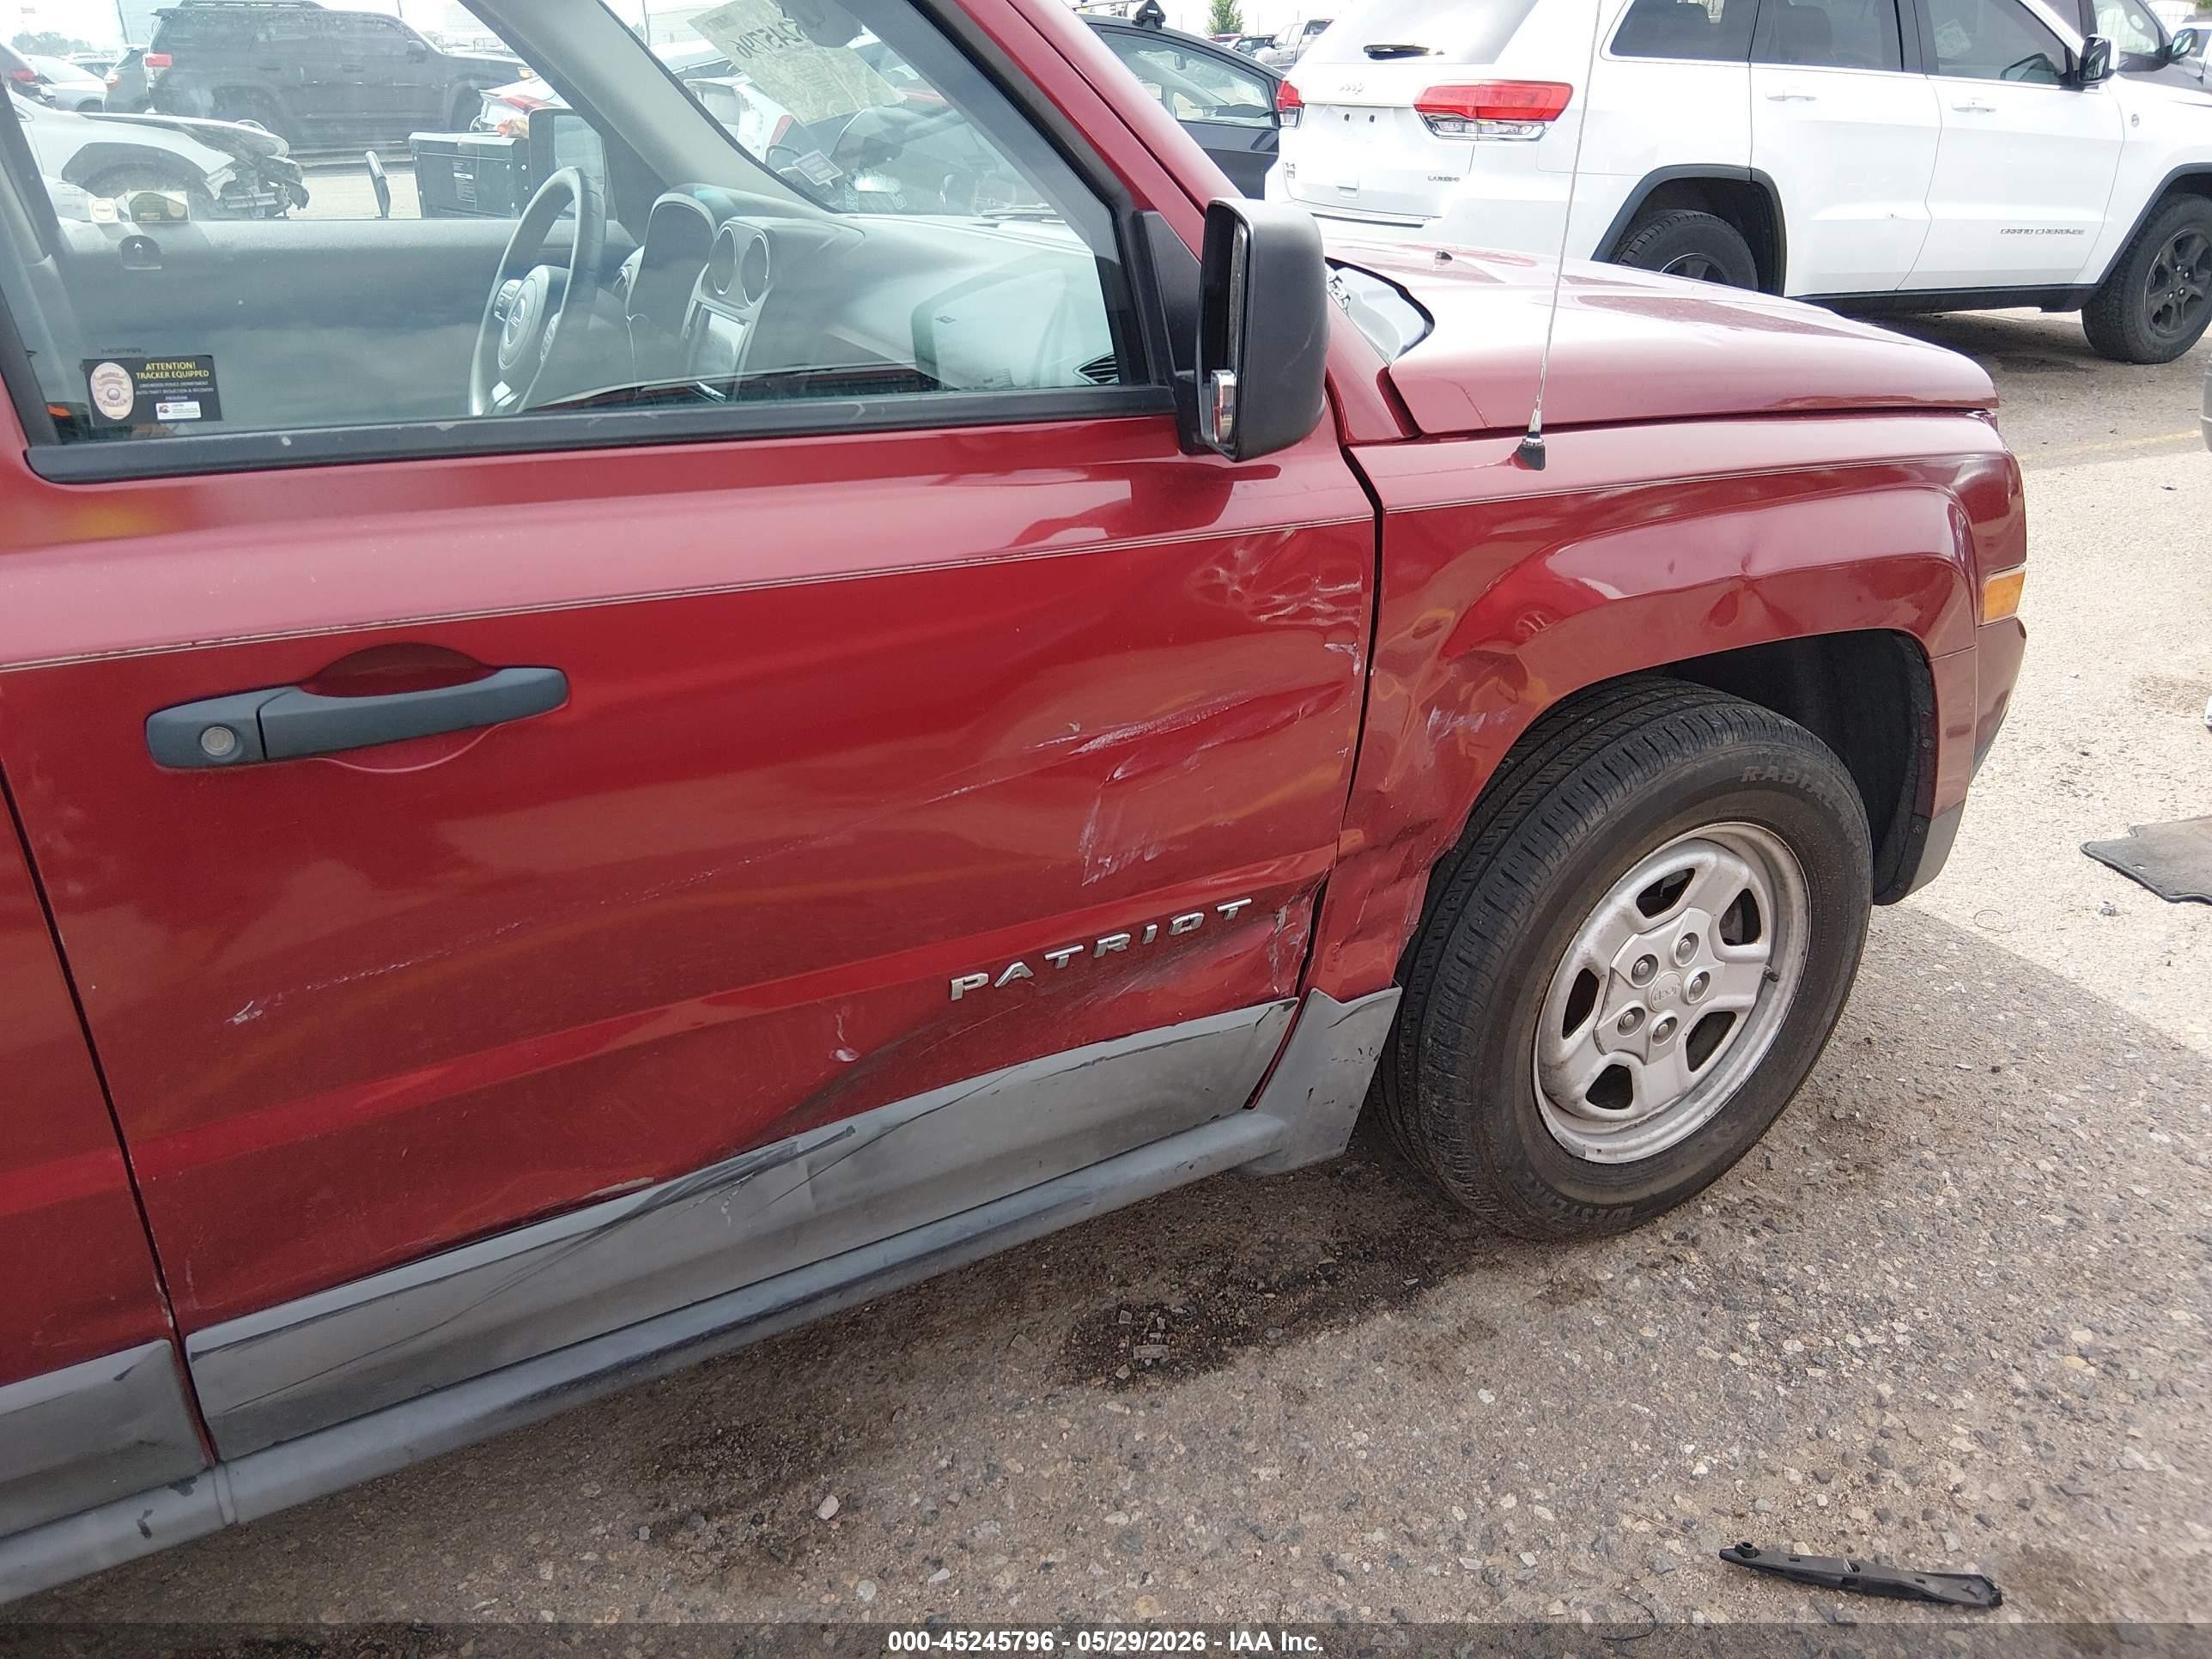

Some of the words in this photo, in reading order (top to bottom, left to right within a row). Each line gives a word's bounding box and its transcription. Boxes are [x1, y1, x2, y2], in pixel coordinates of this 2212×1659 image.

[145, 362, 196, 371] ATTENTION!
[172, 370, 210, 379] EQUIPPED
[950, 897, 1253, 1001] PATRIOT
